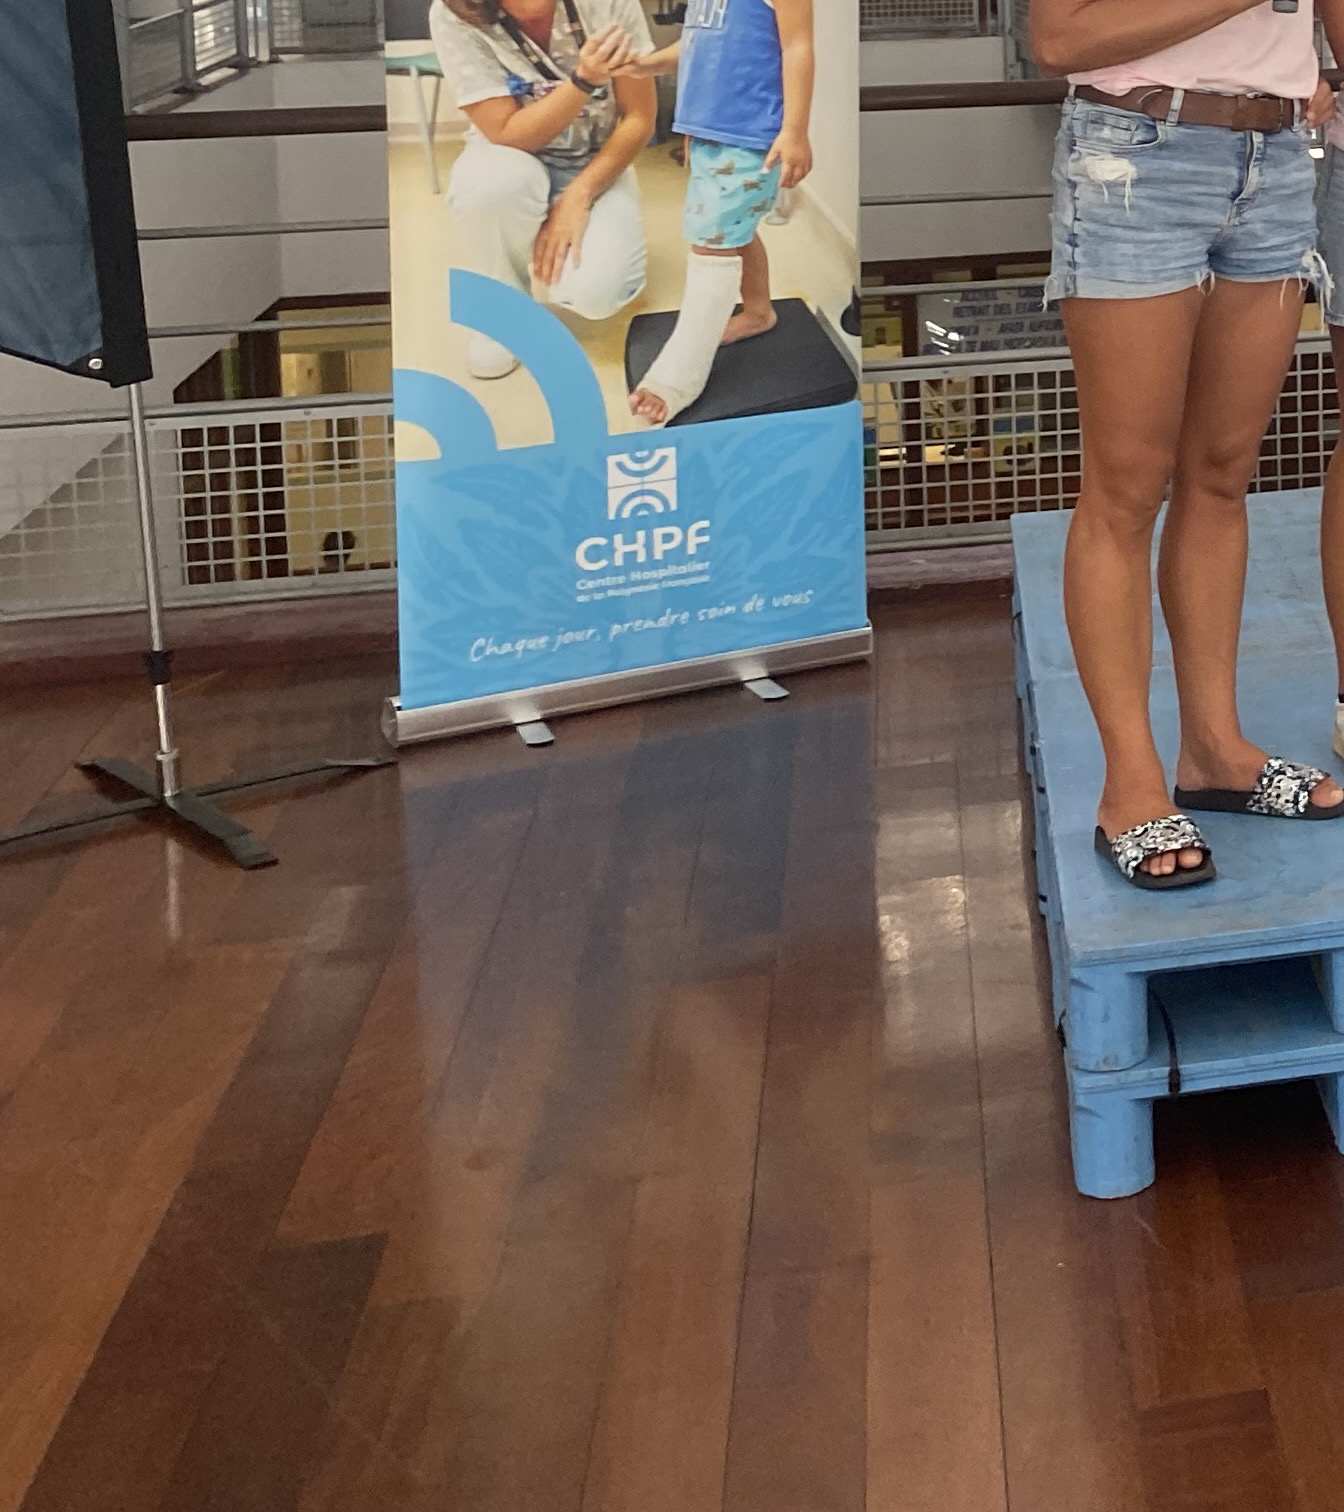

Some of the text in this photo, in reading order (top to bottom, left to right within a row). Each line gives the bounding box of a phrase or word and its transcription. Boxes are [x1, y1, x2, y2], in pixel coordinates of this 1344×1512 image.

[576, 520, 711, 571] CHPF
[576, 575, 626, 589] Centre
[471, 589, 814, 662] Chaque jour, prendre soin de vous
